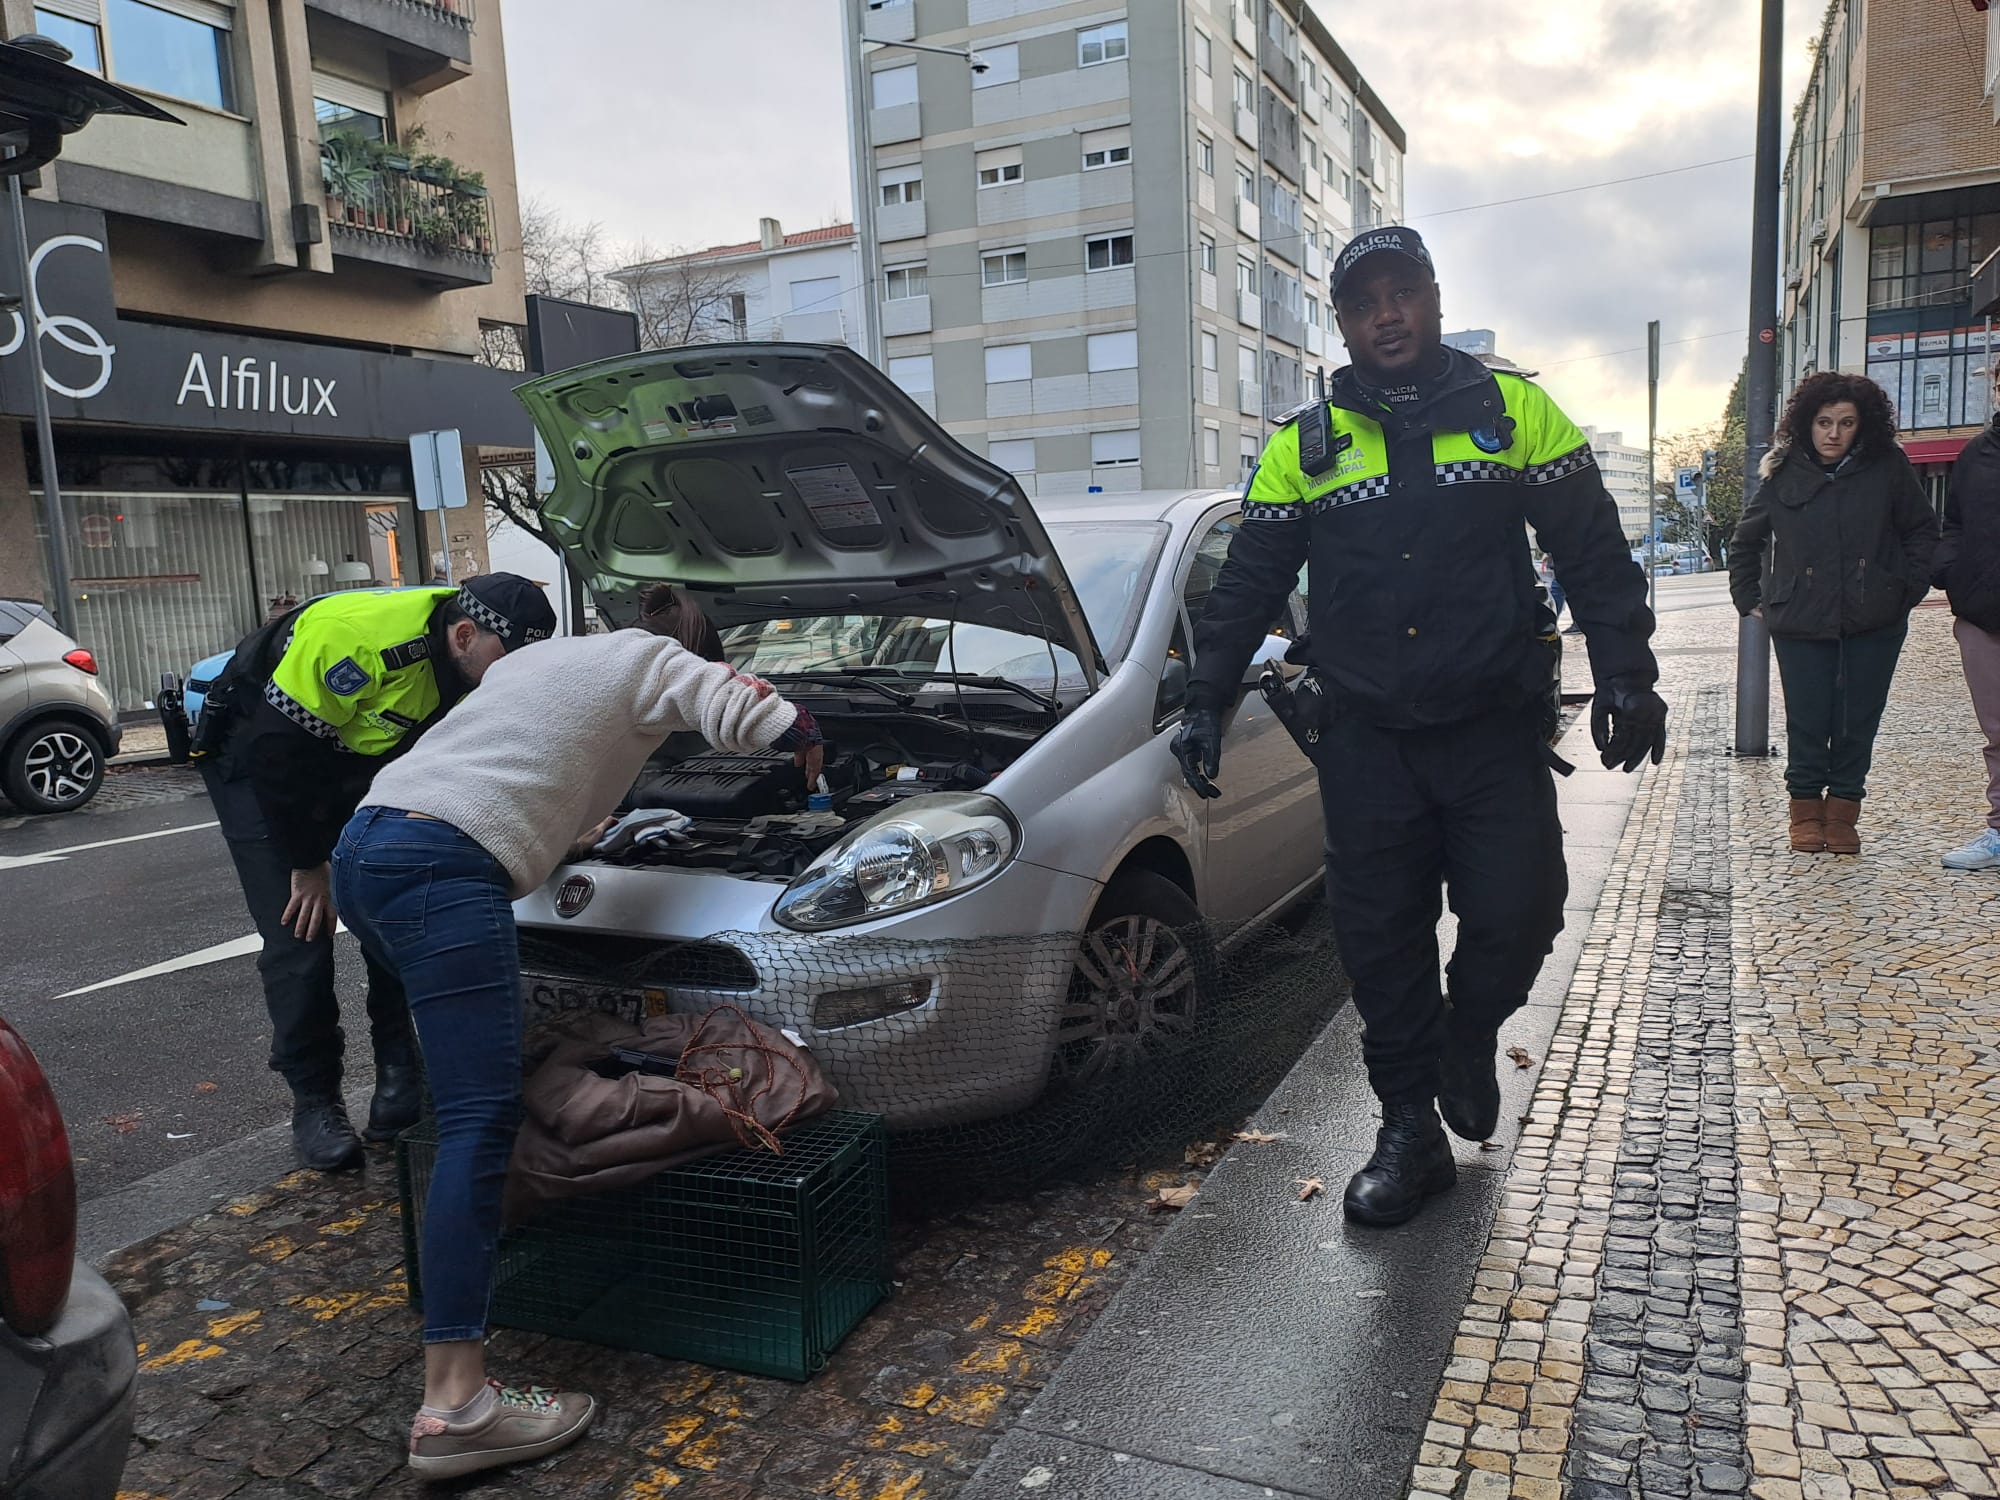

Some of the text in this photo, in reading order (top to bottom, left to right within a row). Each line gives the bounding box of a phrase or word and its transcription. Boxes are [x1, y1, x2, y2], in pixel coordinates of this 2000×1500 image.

[176, 352, 338, 418] Alfilux
[1381, 384, 1417, 396] OLICIA
[561, 885, 586, 904] FIAT
